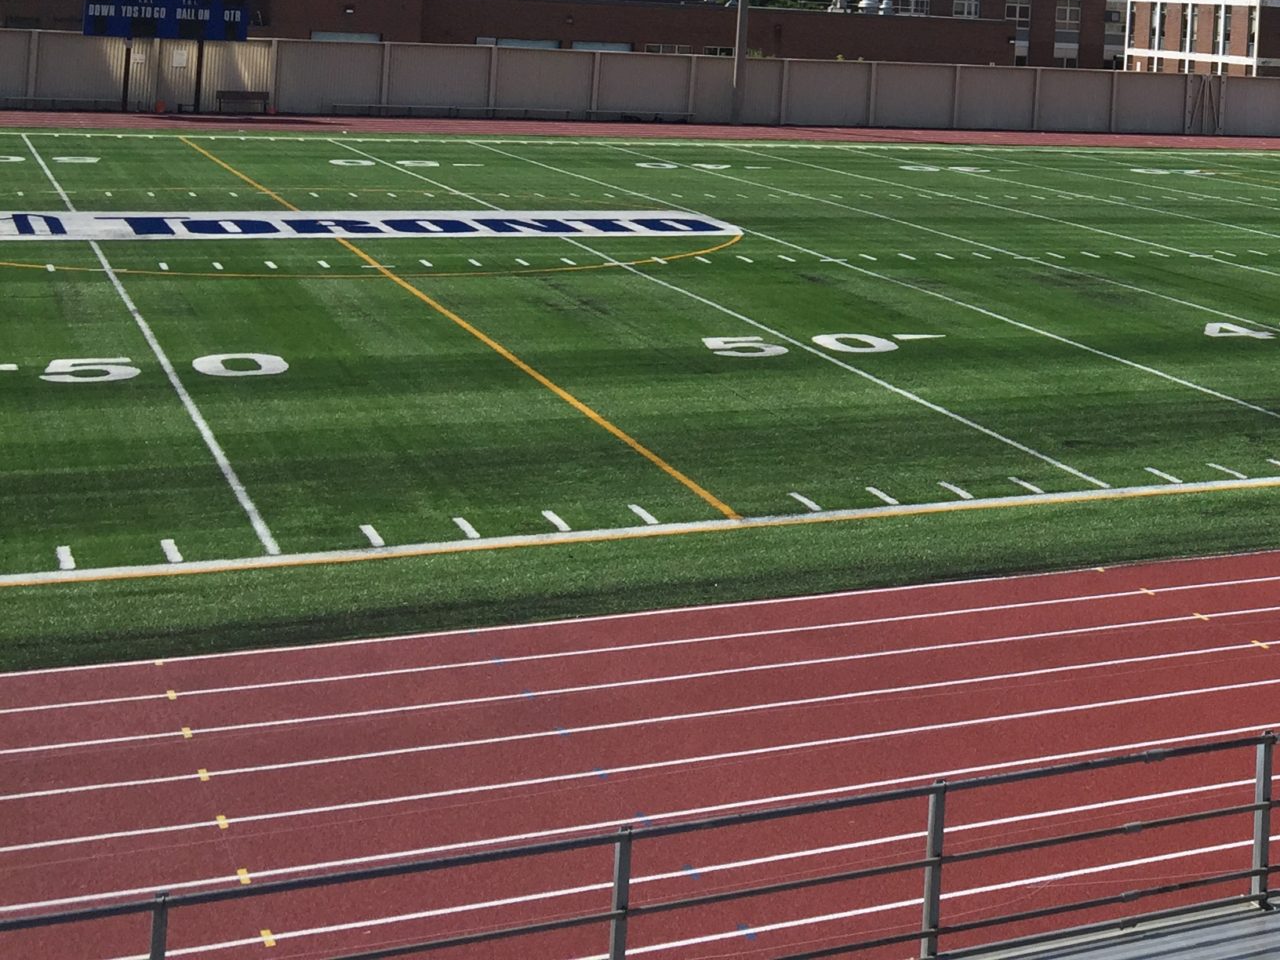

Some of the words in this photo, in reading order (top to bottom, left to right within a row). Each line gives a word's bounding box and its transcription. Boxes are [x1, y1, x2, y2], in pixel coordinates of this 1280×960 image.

[88, 3, 115, 17] DOWN
[121, 5, 139, 18] YDS
[141, 6, 152, 18] TO
[153, 7, 166, 19] GO
[176, 7, 195, 20] BALL
[197, 8, 210, 21] ON
[223, 9, 241, 22] QTR
[96, 216, 724, 235] TORONTO
